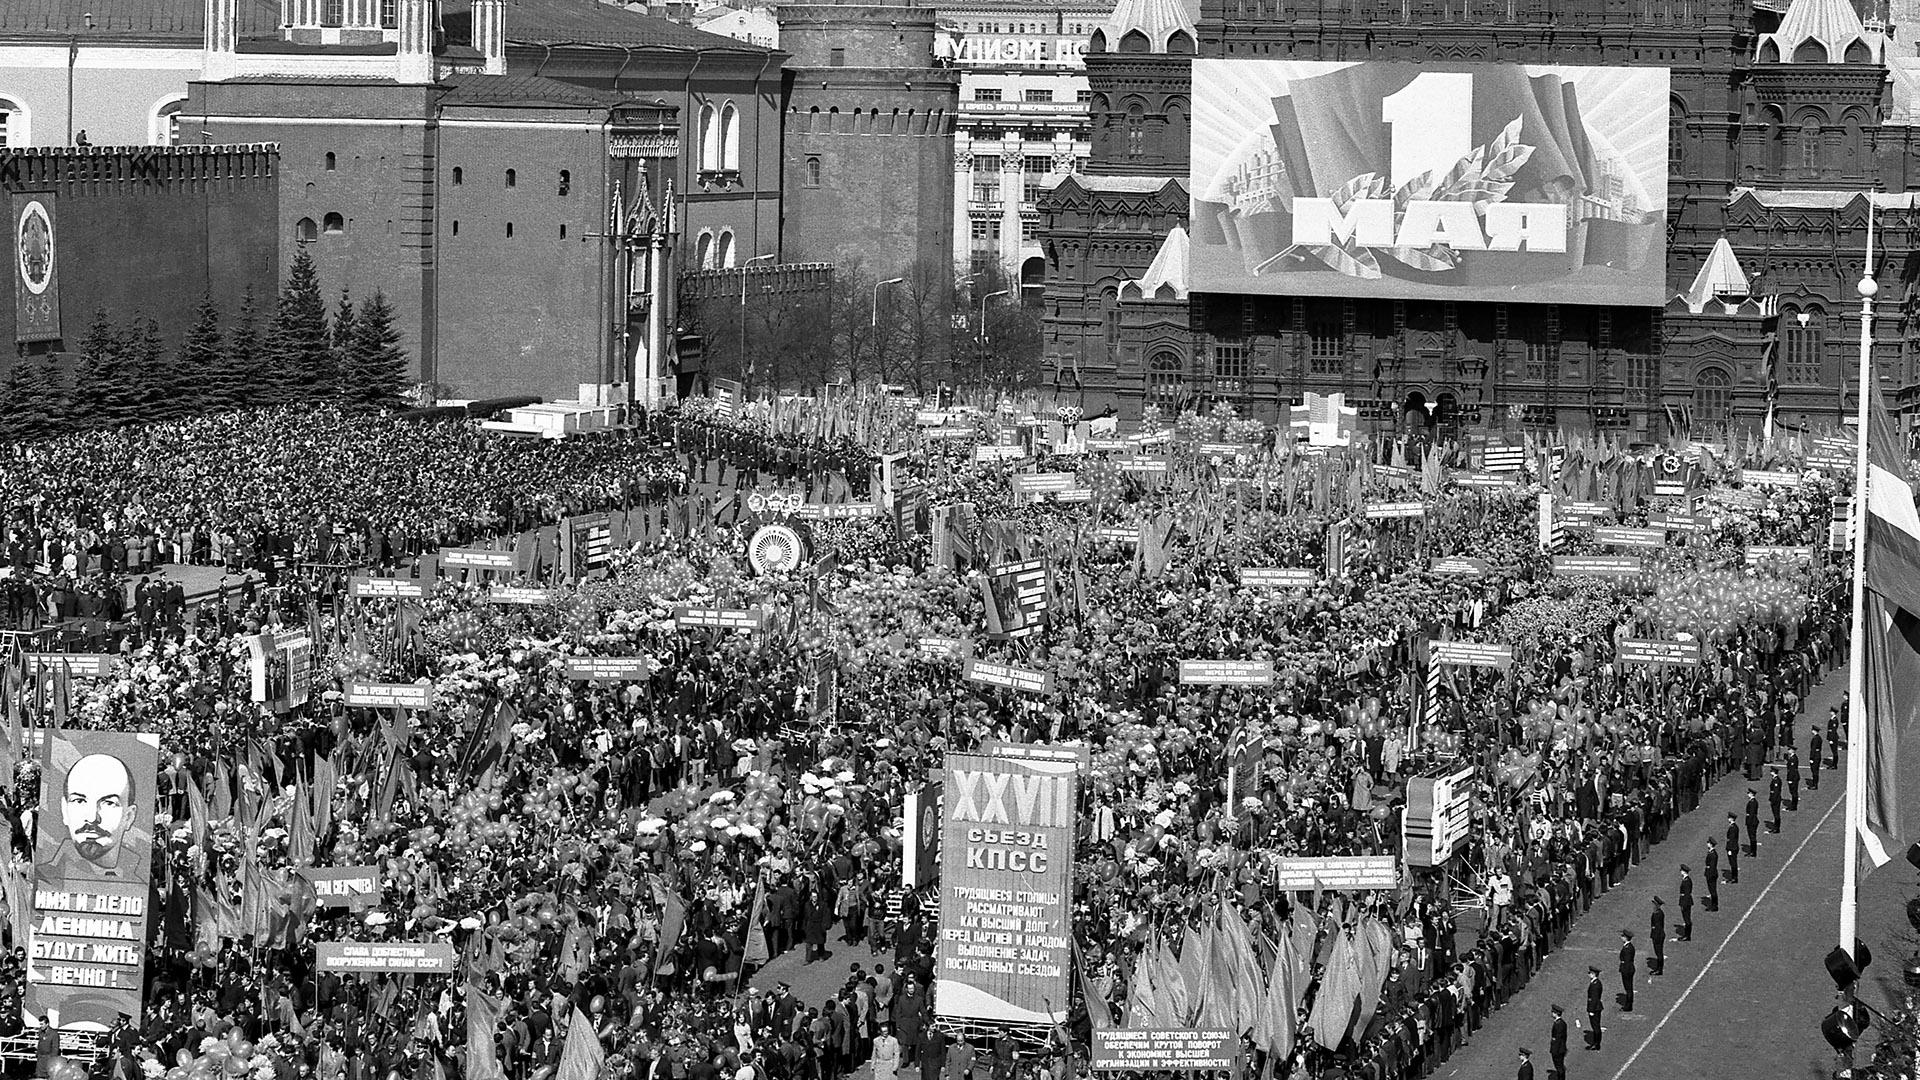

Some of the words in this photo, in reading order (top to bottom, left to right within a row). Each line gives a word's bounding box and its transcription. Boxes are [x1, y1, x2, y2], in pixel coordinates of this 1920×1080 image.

[948, 38, 1041, 61] УНИЗМ
[1383, 72, 1473, 198] 1
[1293, 197, 1566, 252] МАЯ
[952, 770, 1068, 828] XXVII
[968, 828, 1048, 850] СЪЕЗД
[968, 847, 1048, 873] КПСС
[35, 890, 70, 910] ИМЯ
[75, 893, 88, 912] И
[95, 894, 143, 915] ДЕЛО
[953, 887, 1012, 901] ТРУДЯЩИЕСЯ
[1016, 891, 1059, 905] СТОЛИЦЫ
[967, 902, 1044, 918] РАССМАТРИВАЮТ
[38, 916, 133, 938] ЛЕНИНА
[960, 916, 979, 928] КАК
[981, 917, 1021, 931] ВЫСШИЙ
[1024, 921, 1049, 933] ДОЛГ
[942, 929, 971, 943] ПЕРЕД
[973, 930, 1012, 945] ПАРТИЕЙ
[1016, 934, 1022, 945] И
[1025, 935, 1067, 949] НАРОДОМ
[34, 940, 88, 961] БУДУТ
[92, 944, 139, 965] ЖИТЬ
[344, 946, 369, 957] СЛАВА
[372, 947, 426, 958] ДОБЛЕСТНЫМ
[958, 944, 1017, 959] ВЫПОЛНЕНИЕ
[327, 956, 387, 968] ВООРУЖЕННЫМ
[388, 957, 416, 968] СИЛАМ
[945, 957, 1014, 973] ПОСТАВЛЕННЫХ
[1018, 963, 1060, 977] СЪЕЗДОМ
[1096, 1031, 1147, 1043] ТРУДЯЩИЕСЯ
[1150, 1031, 1199, 1042] СОВЕТСКОГО
[1201, 1031, 1230, 1042] СОЮЗА!
[1104, 1041, 1150, 1051] ОБЕСПЕЧИМ
[1154, 1040, 1183, 1050] КРУТОЙ
[1188, 1040, 1222, 1050] ПОВОРОТ
[1118, 1050, 1124, 1059] К
[1126, 1050, 1172, 1059] ЭКОНОМИКЕ
[1175, 1048, 1210, 1059] ВЫСШЕЙ
[1096, 1059, 1150, 1070] ОРГАНИЗАЦИИ
[1152, 1059, 1158, 1068] И
[1161, 1059, 1230, 1069] ЭФФЕКТИВНОСТИ!
